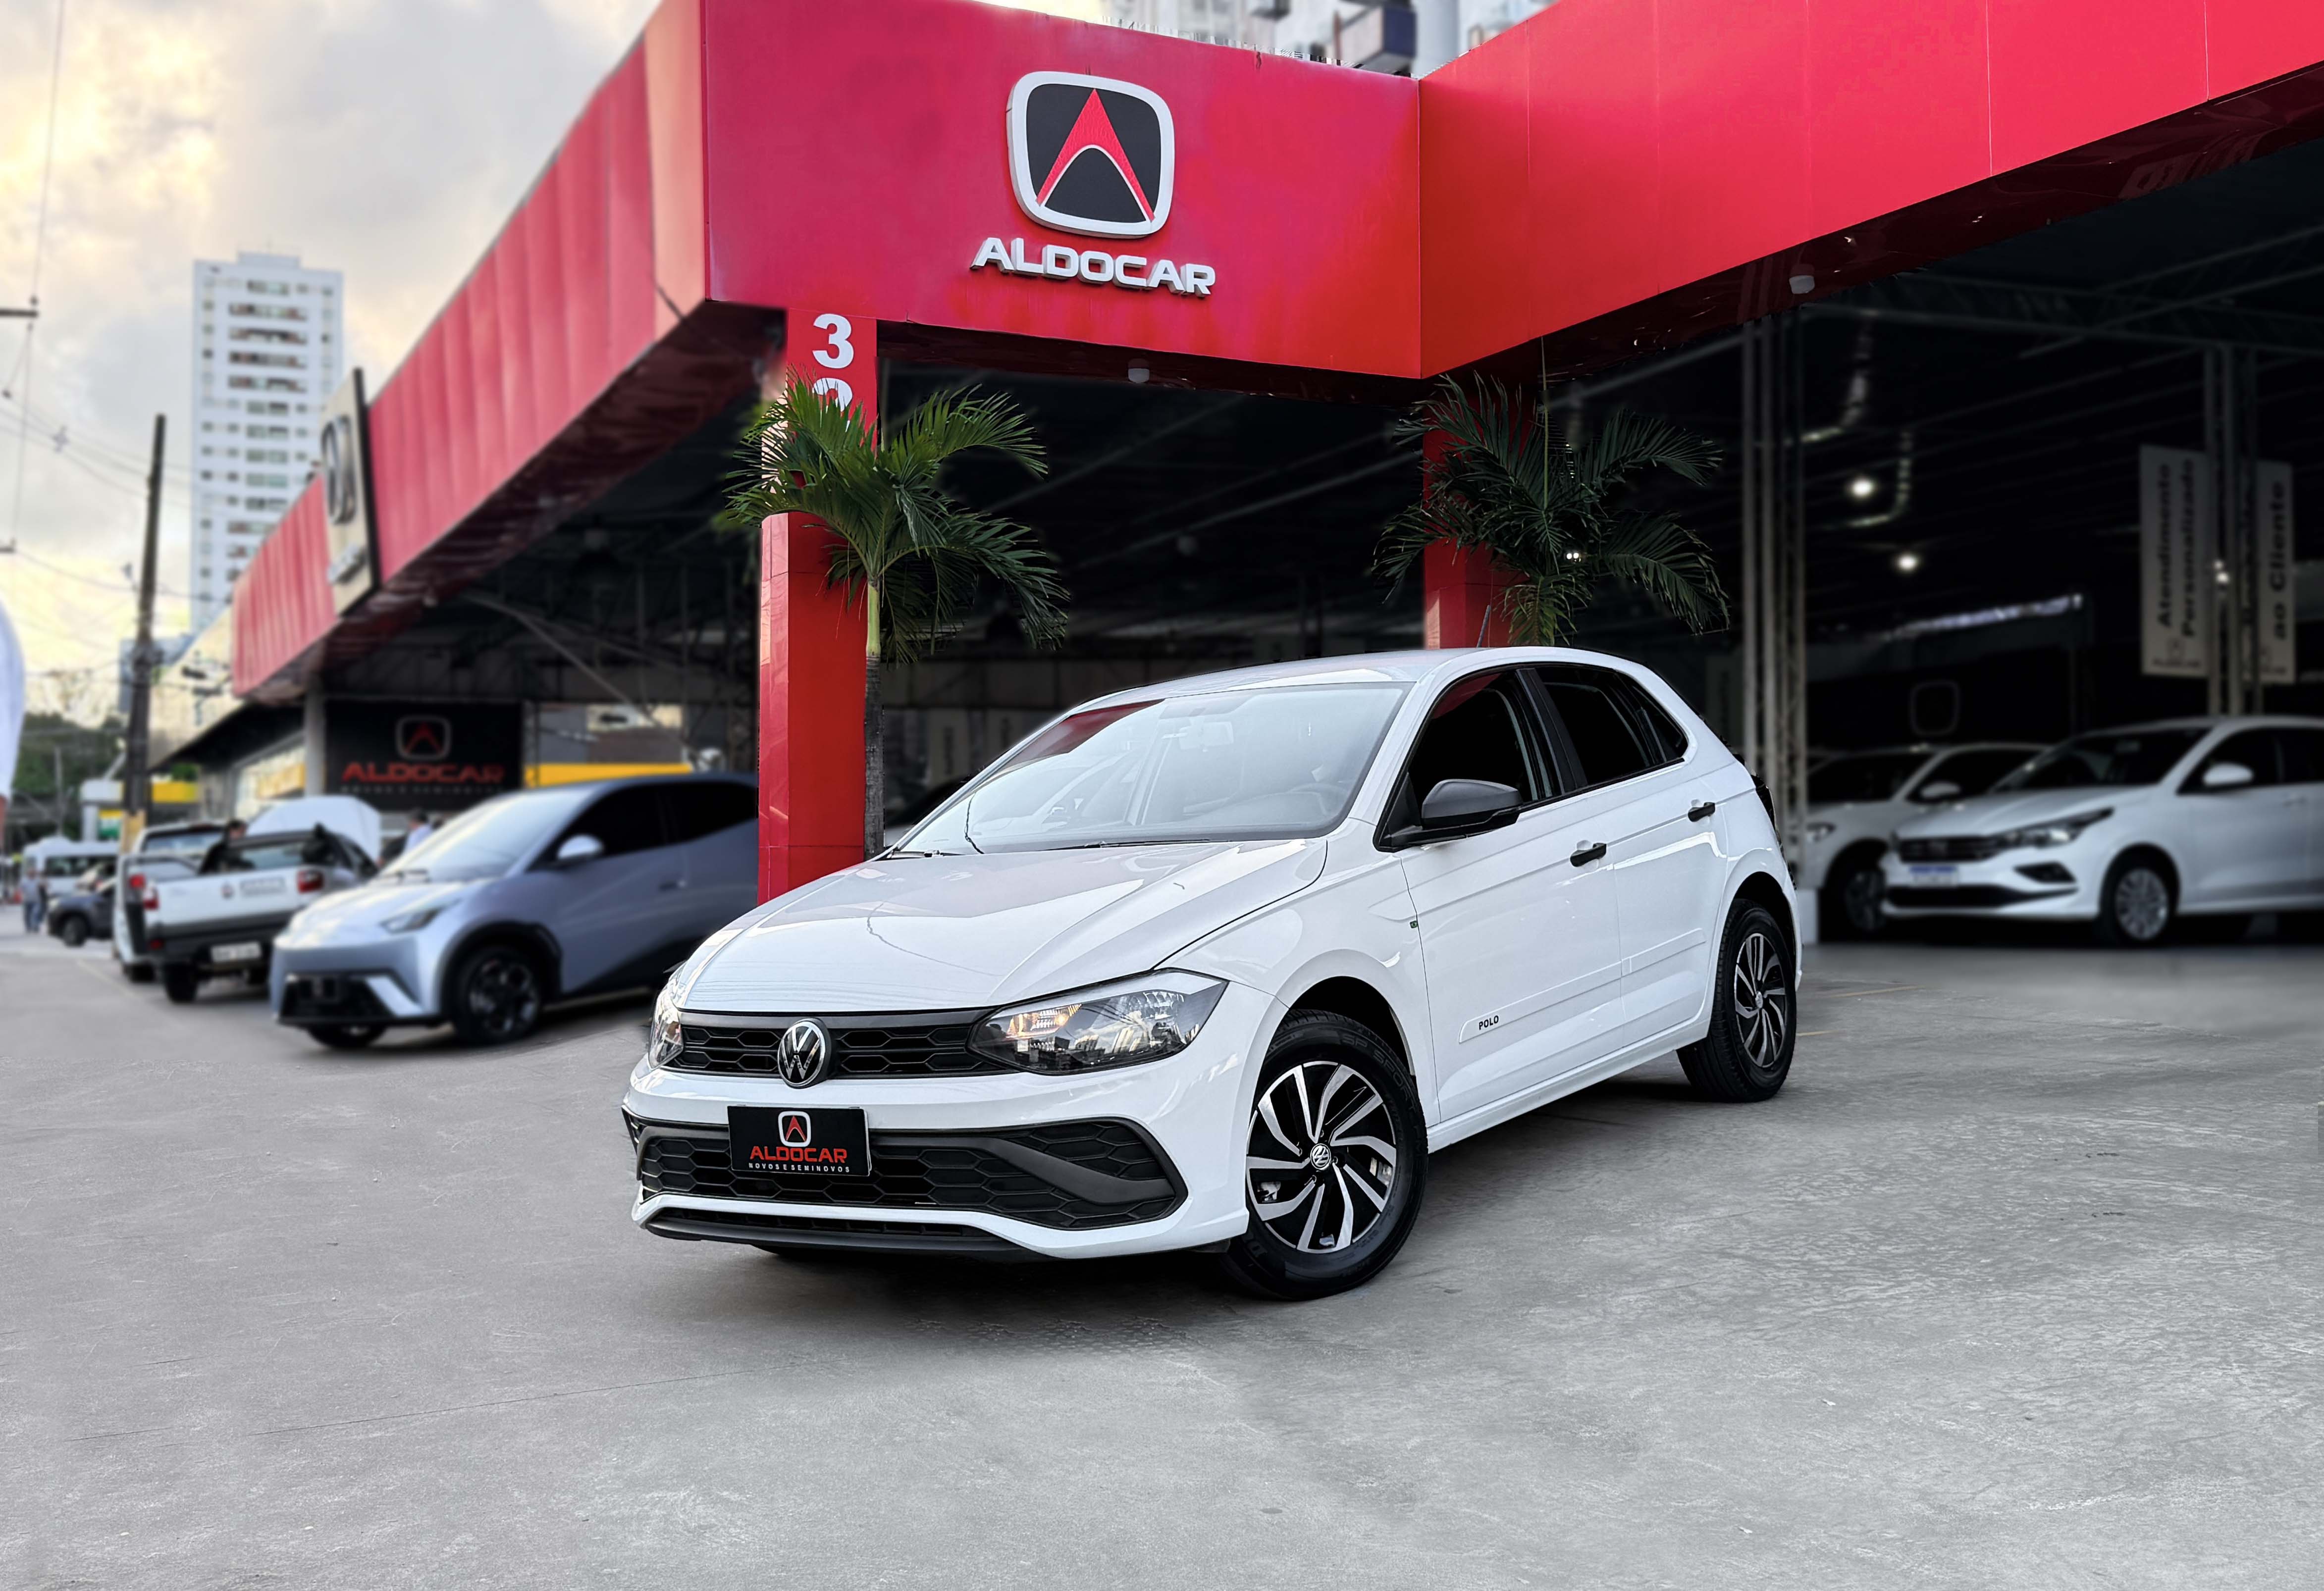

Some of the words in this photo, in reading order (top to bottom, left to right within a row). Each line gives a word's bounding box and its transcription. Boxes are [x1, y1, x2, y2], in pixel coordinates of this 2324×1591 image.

[970, 237, 1216, 298] ALDOCAR
[2157, 463, 2172, 628] Atendimento
[2180, 459, 2196, 637] Personalizado
[2268, 481, 2286, 592] Cliente
[2273, 603, 2287, 640] ao
[342, 762, 504, 783] ALDOCAR
[1479, 1015, 1499, 1030] POLO
[749, 1146, 847, 1163] ALDOCAR
